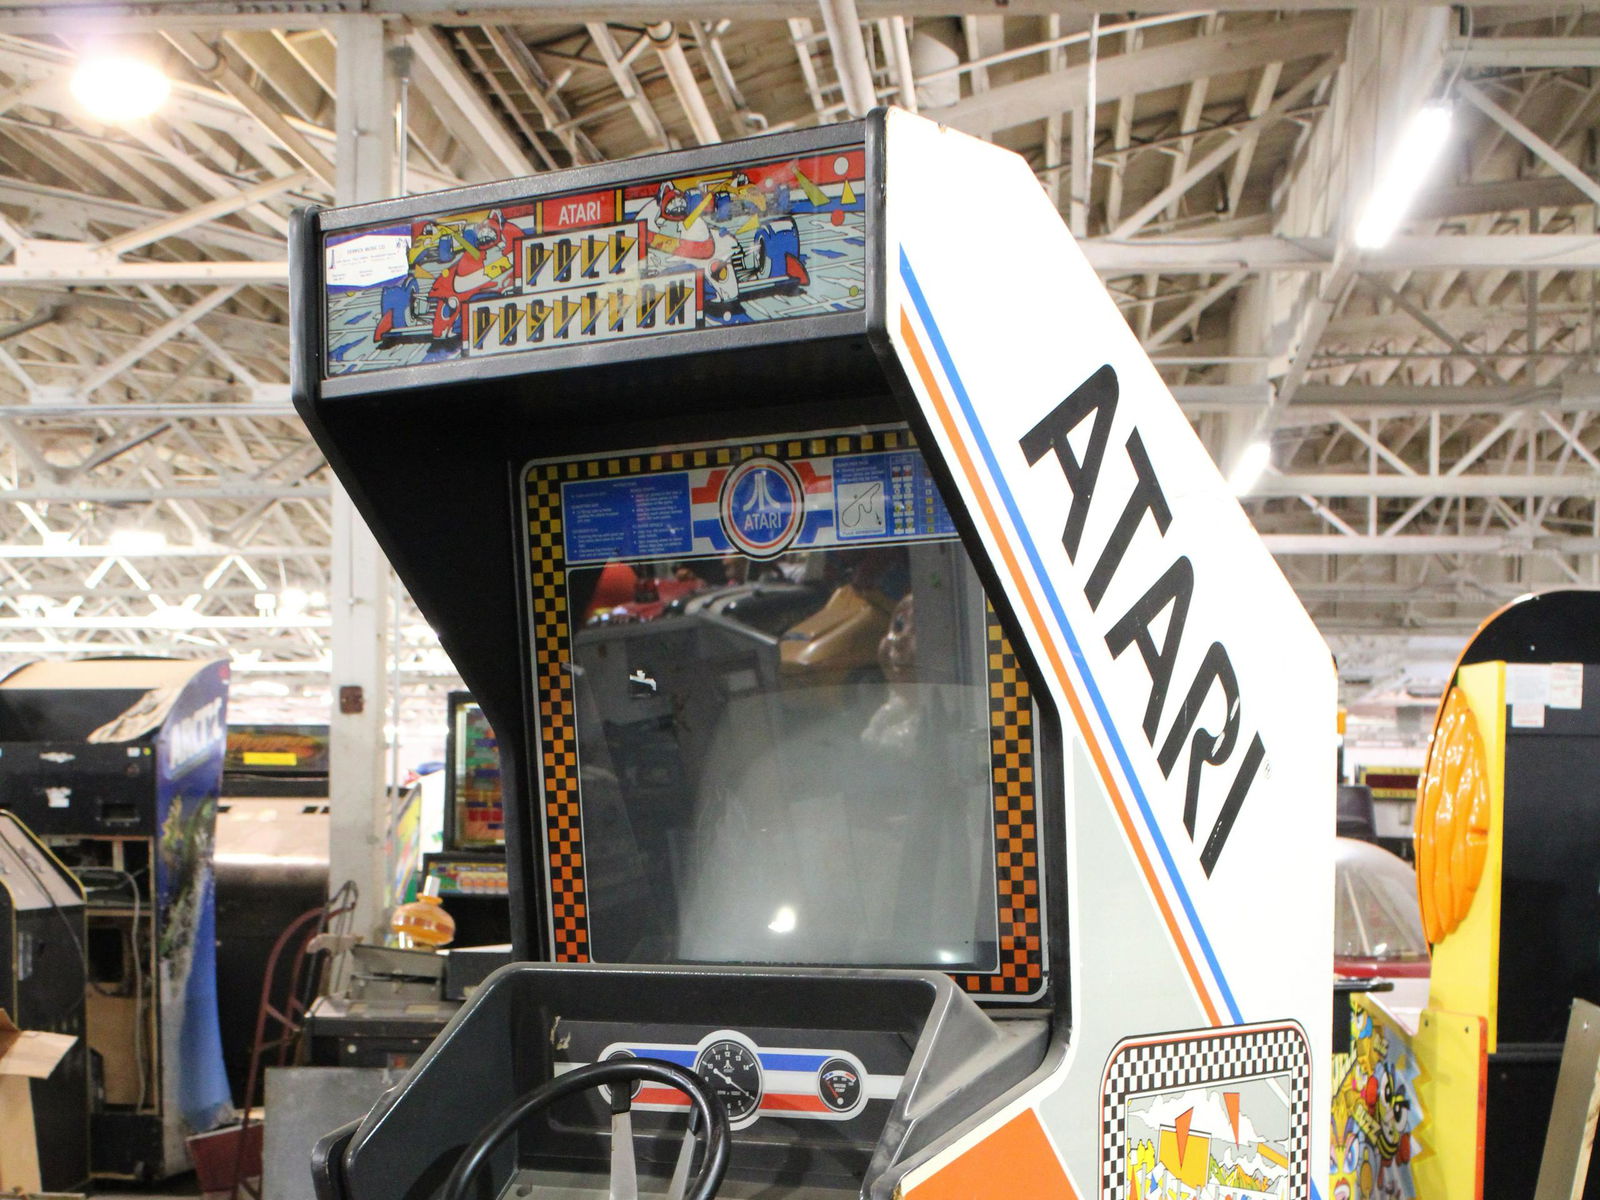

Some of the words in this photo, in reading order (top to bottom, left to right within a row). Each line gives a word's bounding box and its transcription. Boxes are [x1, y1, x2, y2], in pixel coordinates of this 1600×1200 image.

[558, 201, 601, 226] ATARI
[526, 230, 638, 287] POLE
[473, 280, 695, 350] POSITION
[744, 512, 782, 531] ATARI
[1019, 363, 1266, 881] ATARI
